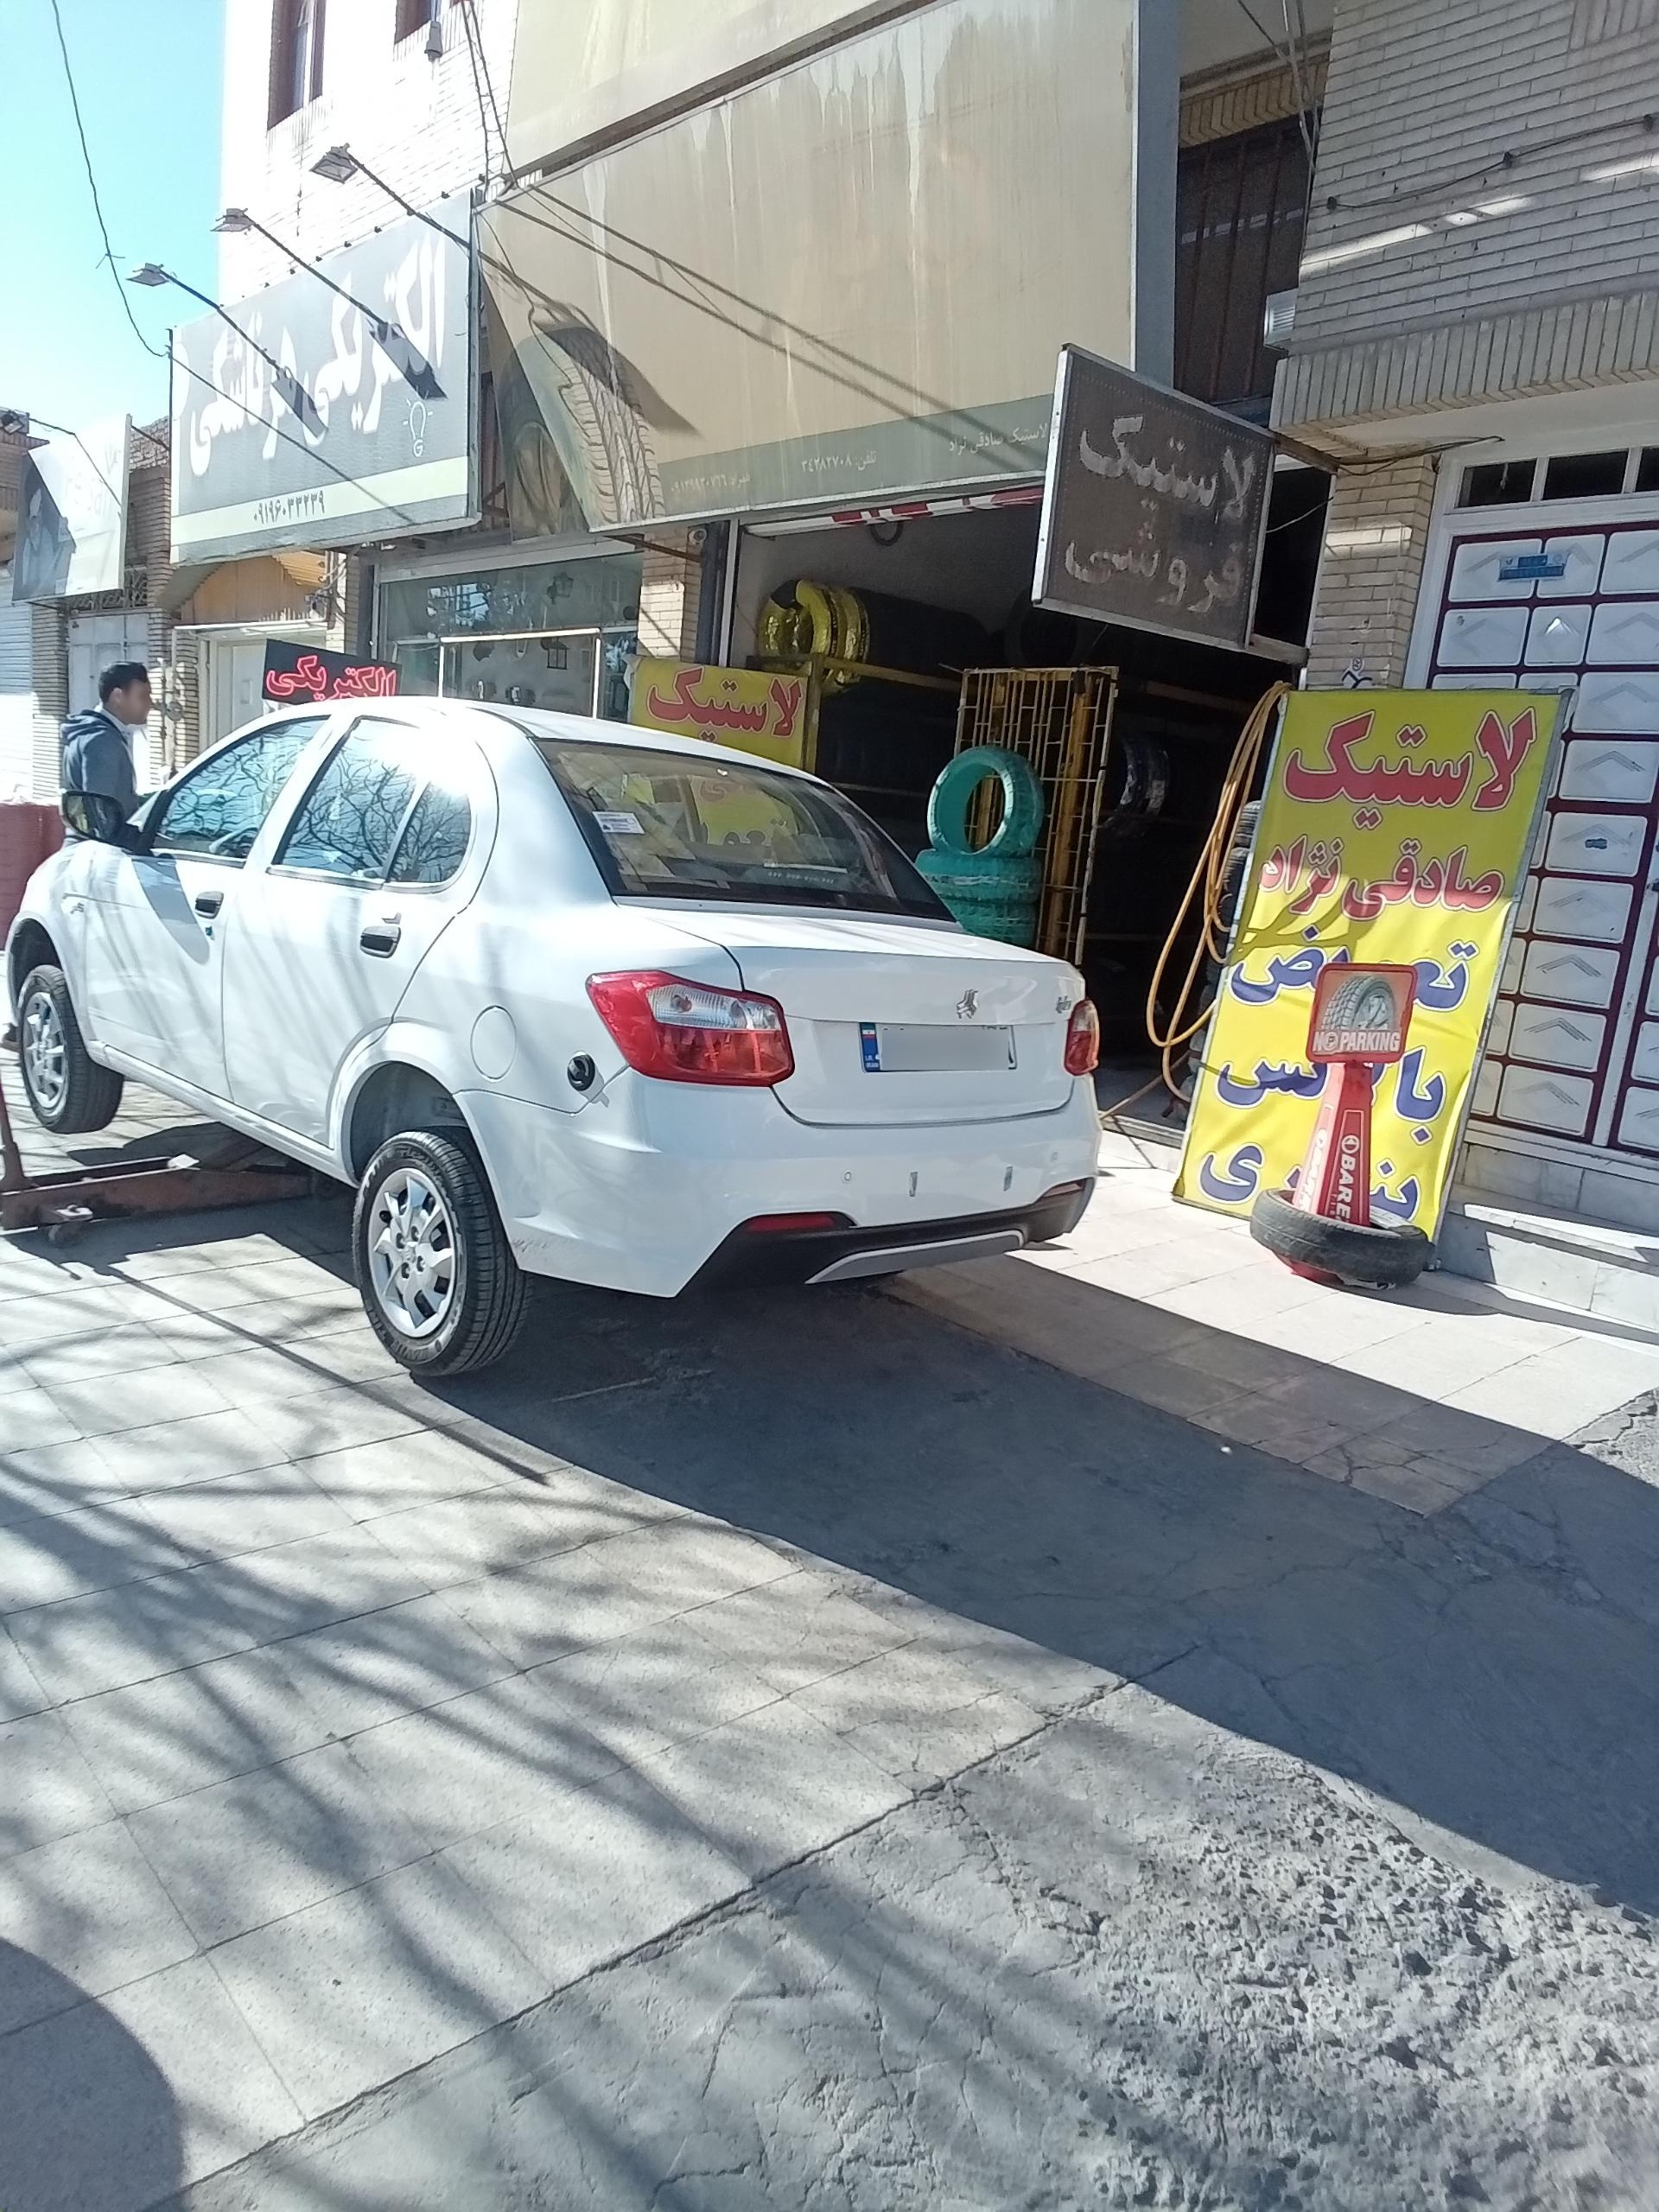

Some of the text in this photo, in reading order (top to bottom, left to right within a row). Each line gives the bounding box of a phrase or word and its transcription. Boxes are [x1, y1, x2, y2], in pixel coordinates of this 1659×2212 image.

[1080, 415, 1254, 518] لاستیک
[1065, 520, 1243, 613] فروشی
[647, 666, 803, 742] لاستیک
[1283, 707, 1536, 830] لاستیک
[1259, 835, 1505, 920] صادقی نژاد
[1339, 1031, 1402, 1052] PARKING
[1336, 1154, 1357, 1222] BARE
